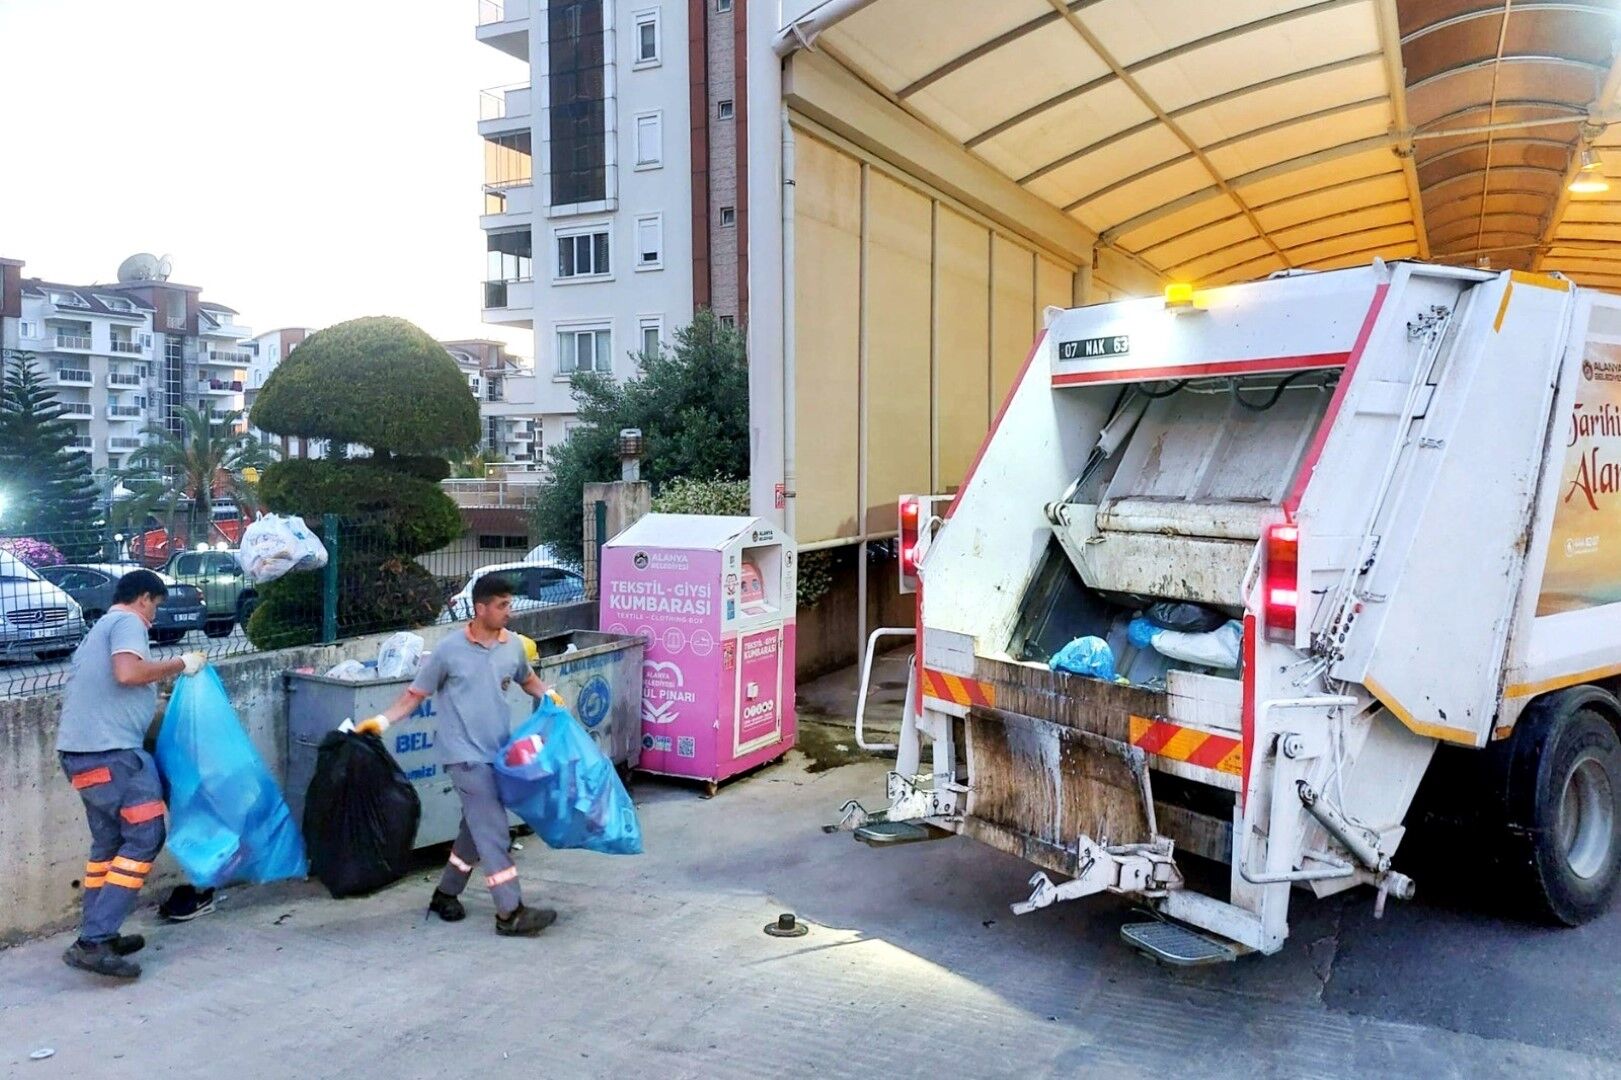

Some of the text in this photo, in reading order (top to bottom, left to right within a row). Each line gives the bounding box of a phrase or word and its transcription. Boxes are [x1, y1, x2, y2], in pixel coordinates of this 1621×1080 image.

[1064, 336, 1128, 358] 07 NAK 63
[651, 553, 688, 563] ALANYA
[610, 579, 666, 596] TEKSTİL
[674, 581, 712, 599] GİYSİ
[609, 594, 711, 616] KUMBARASI
[659, 689, 696, 703] PINARI
[395, 731, 434, 753] BEL
